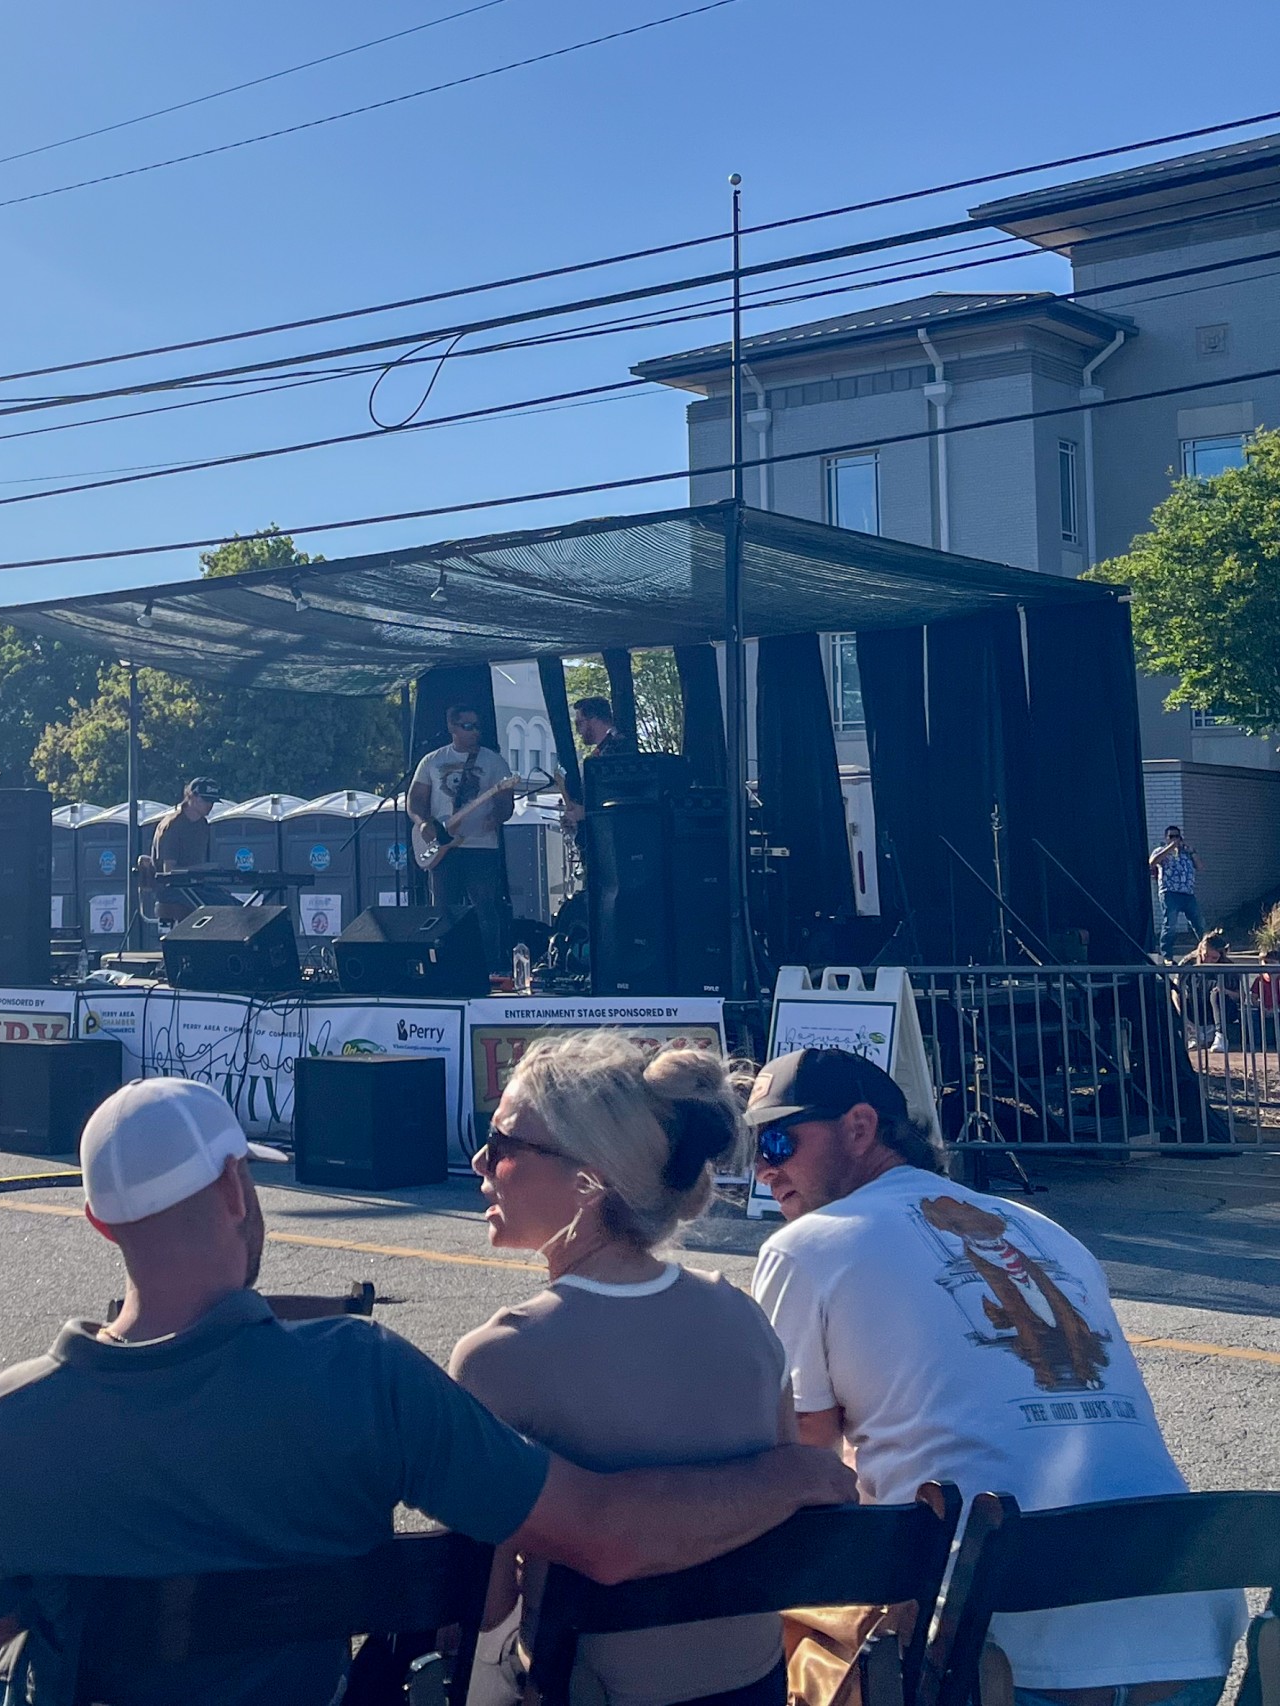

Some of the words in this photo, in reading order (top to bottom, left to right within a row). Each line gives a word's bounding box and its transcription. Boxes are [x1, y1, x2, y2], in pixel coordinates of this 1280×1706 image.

[504, 1009, 575, 1018] ENTERTAINMENT
[577, 1008, 607, 1018] STAGE
[608, 1008, 665, 1018] SPONSORED
[666, 1007, 678, 1017] BY
[203, 1024, 221, 1032] AREA
[409, 1023, 445, 1043] Perry
